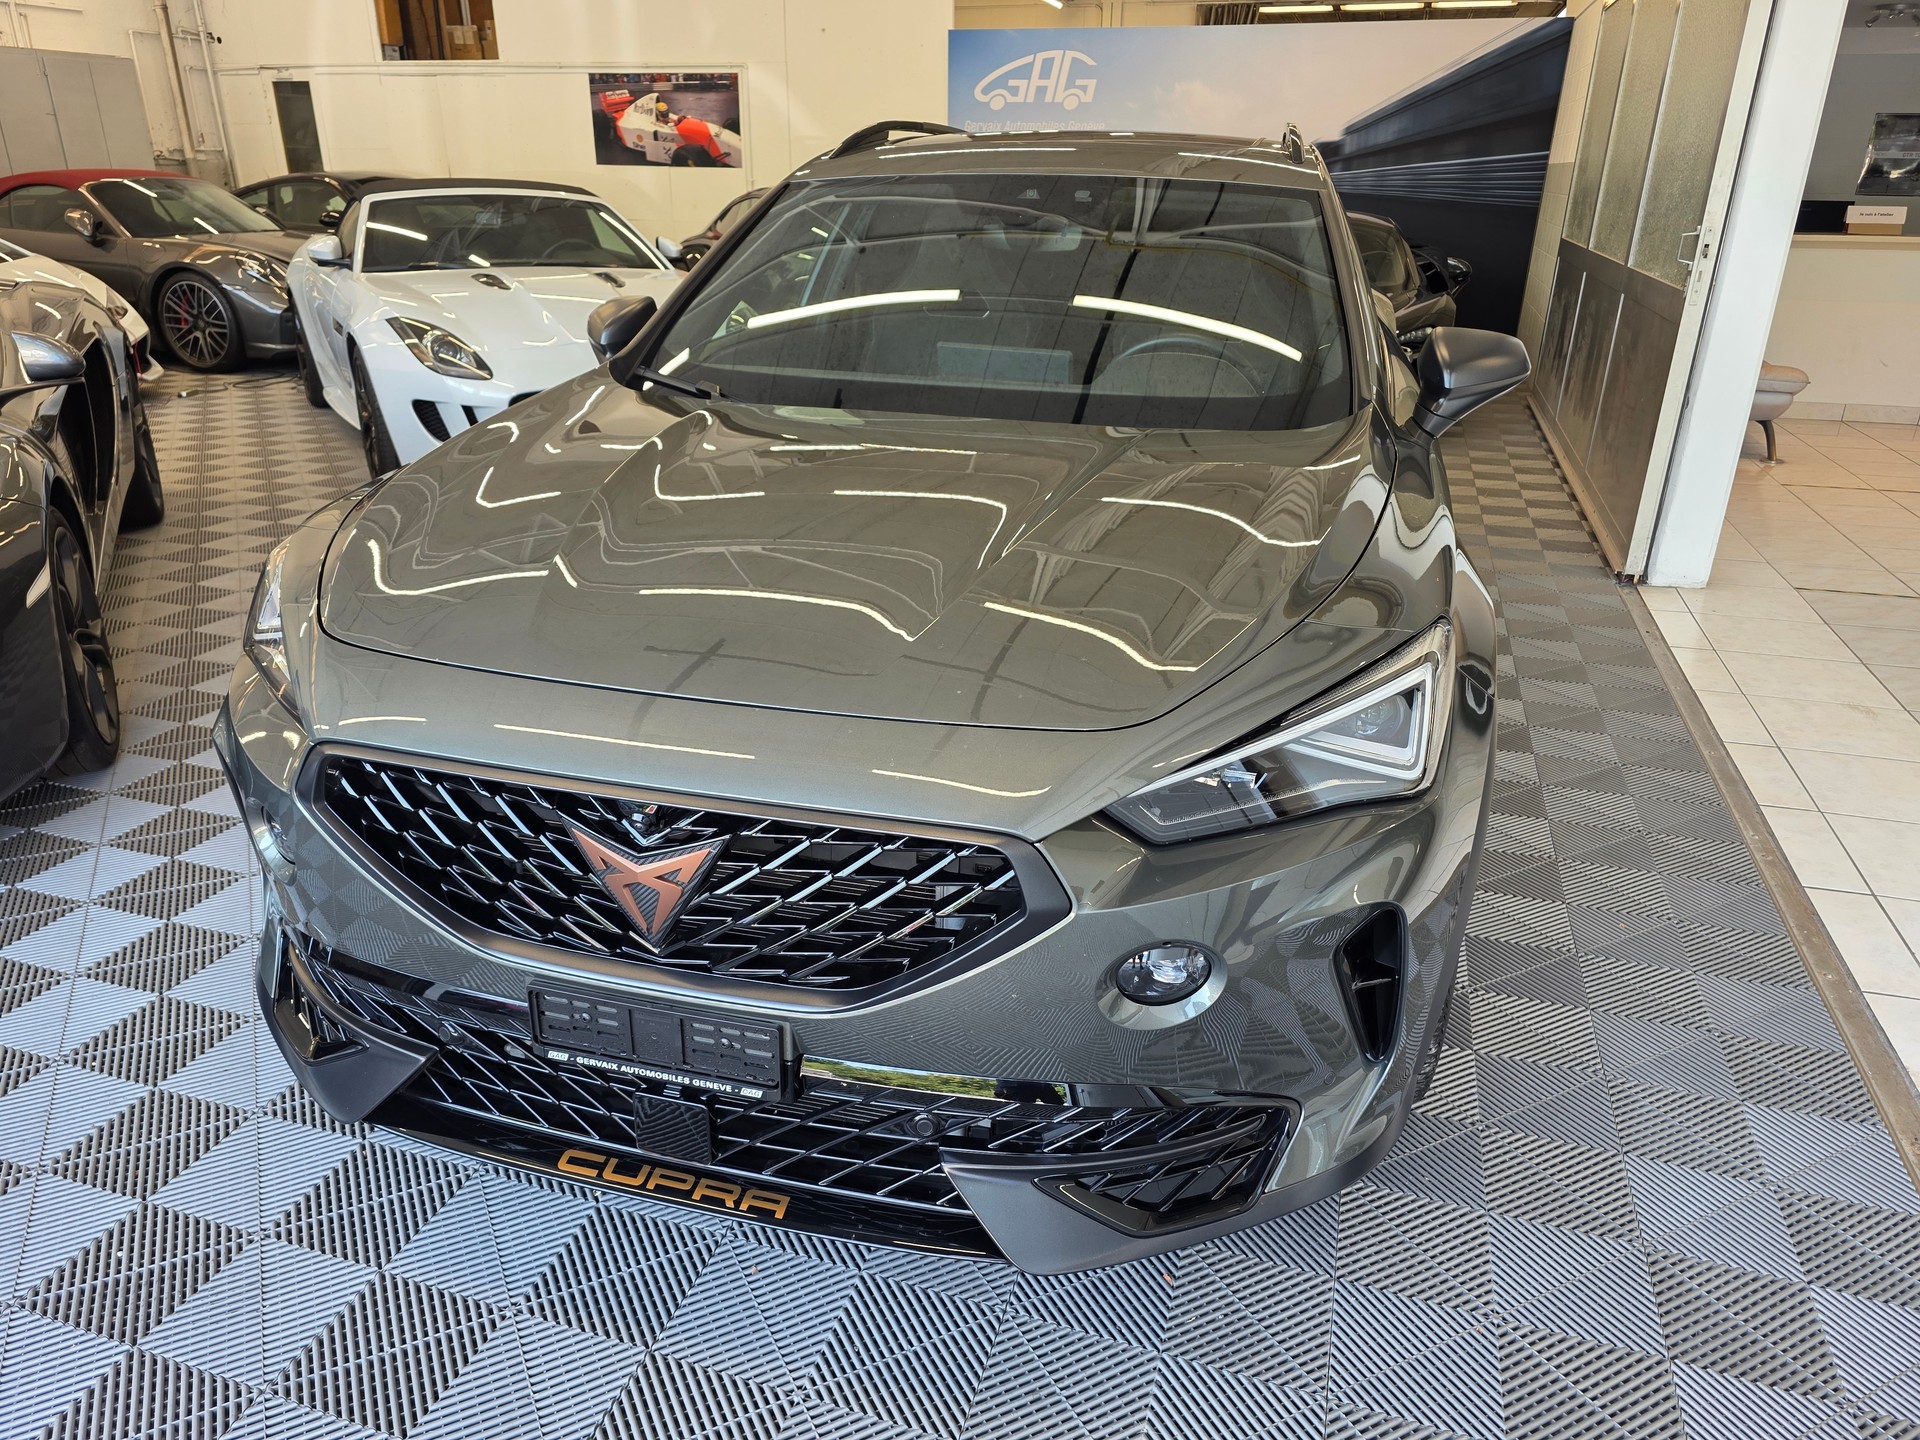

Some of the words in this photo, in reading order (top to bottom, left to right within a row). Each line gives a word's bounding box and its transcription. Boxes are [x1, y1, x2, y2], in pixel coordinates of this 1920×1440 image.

[974, 50, 1097, 110] GAG
[964, 120, 1002, 132] Gervaix
[1004, 120, 1064, 131] Automobiles
[576, 1056, 619, 1071] GERVAIX
[620, 1065, 691, 1085] AUTOMOBILES
[693, 1079, 733, 1093] GENEVE
[557, 1149, 791, 1220] CUPRA
